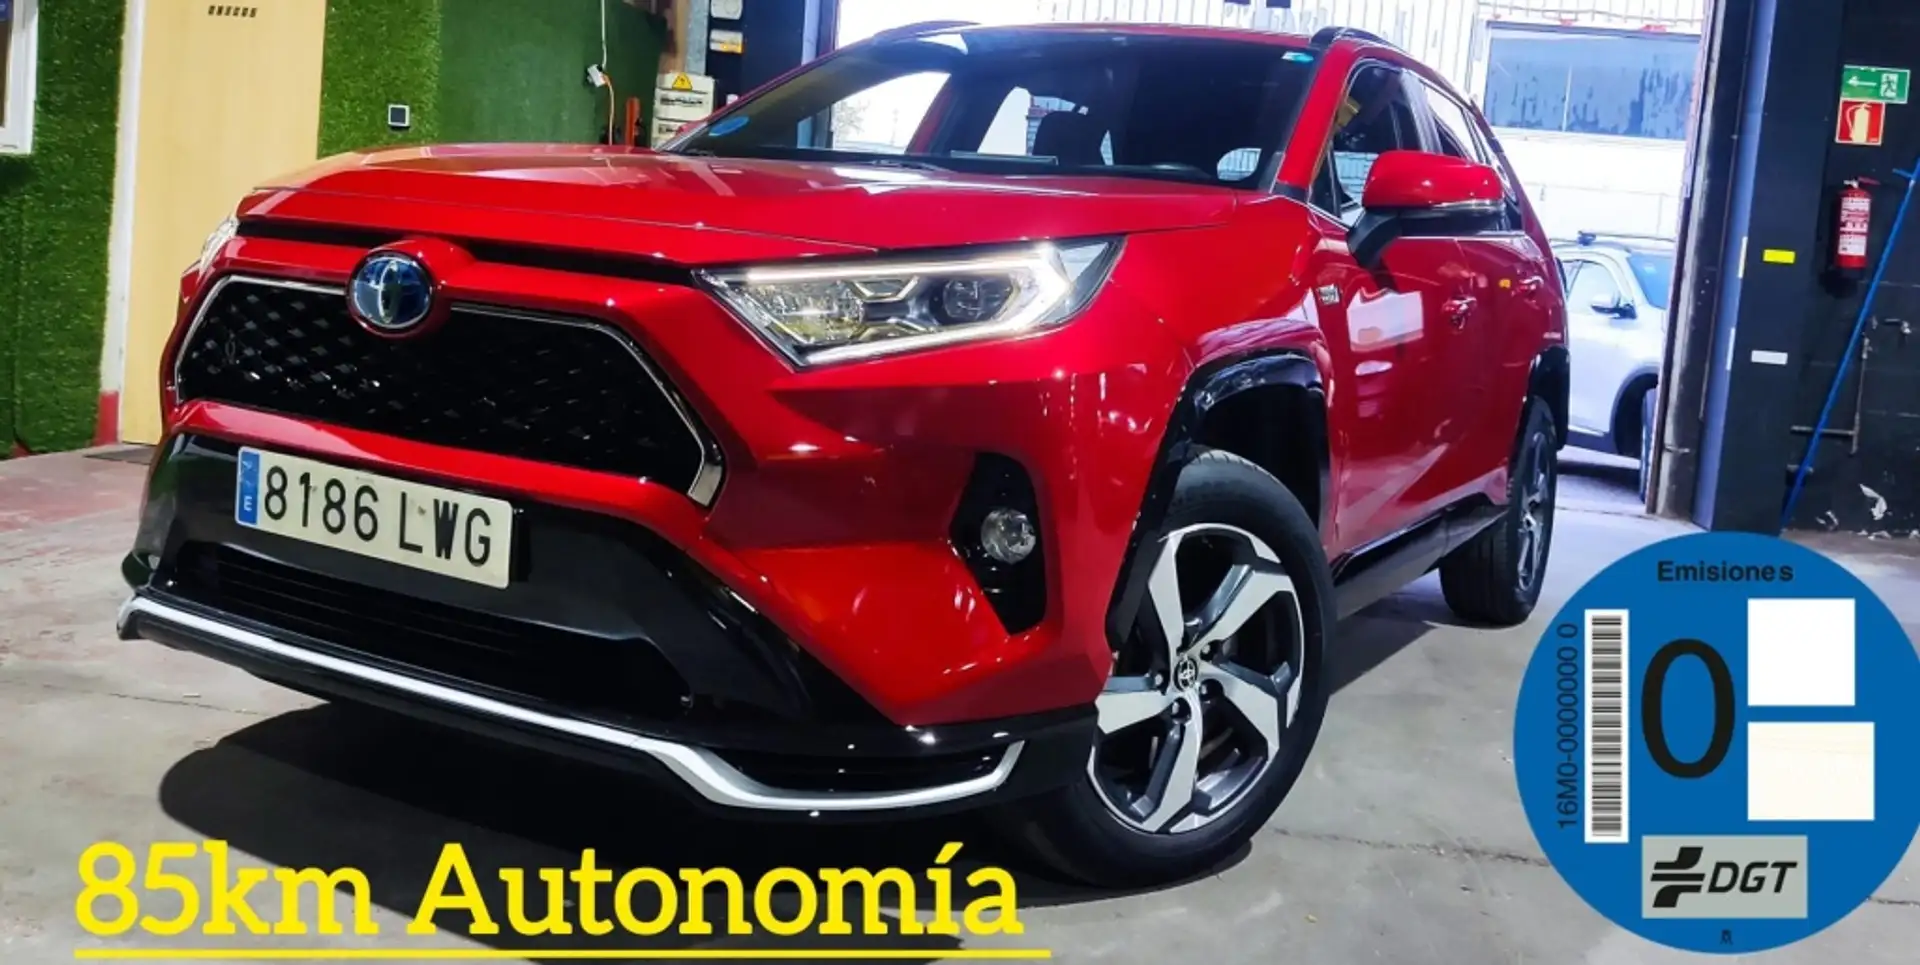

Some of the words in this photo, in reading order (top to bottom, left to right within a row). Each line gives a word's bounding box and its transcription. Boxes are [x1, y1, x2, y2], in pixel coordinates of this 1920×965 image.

[243, 495, 252, 512] E
[264, 465, 379, 542] 8186
[399, 491, 491, 567] LWG
